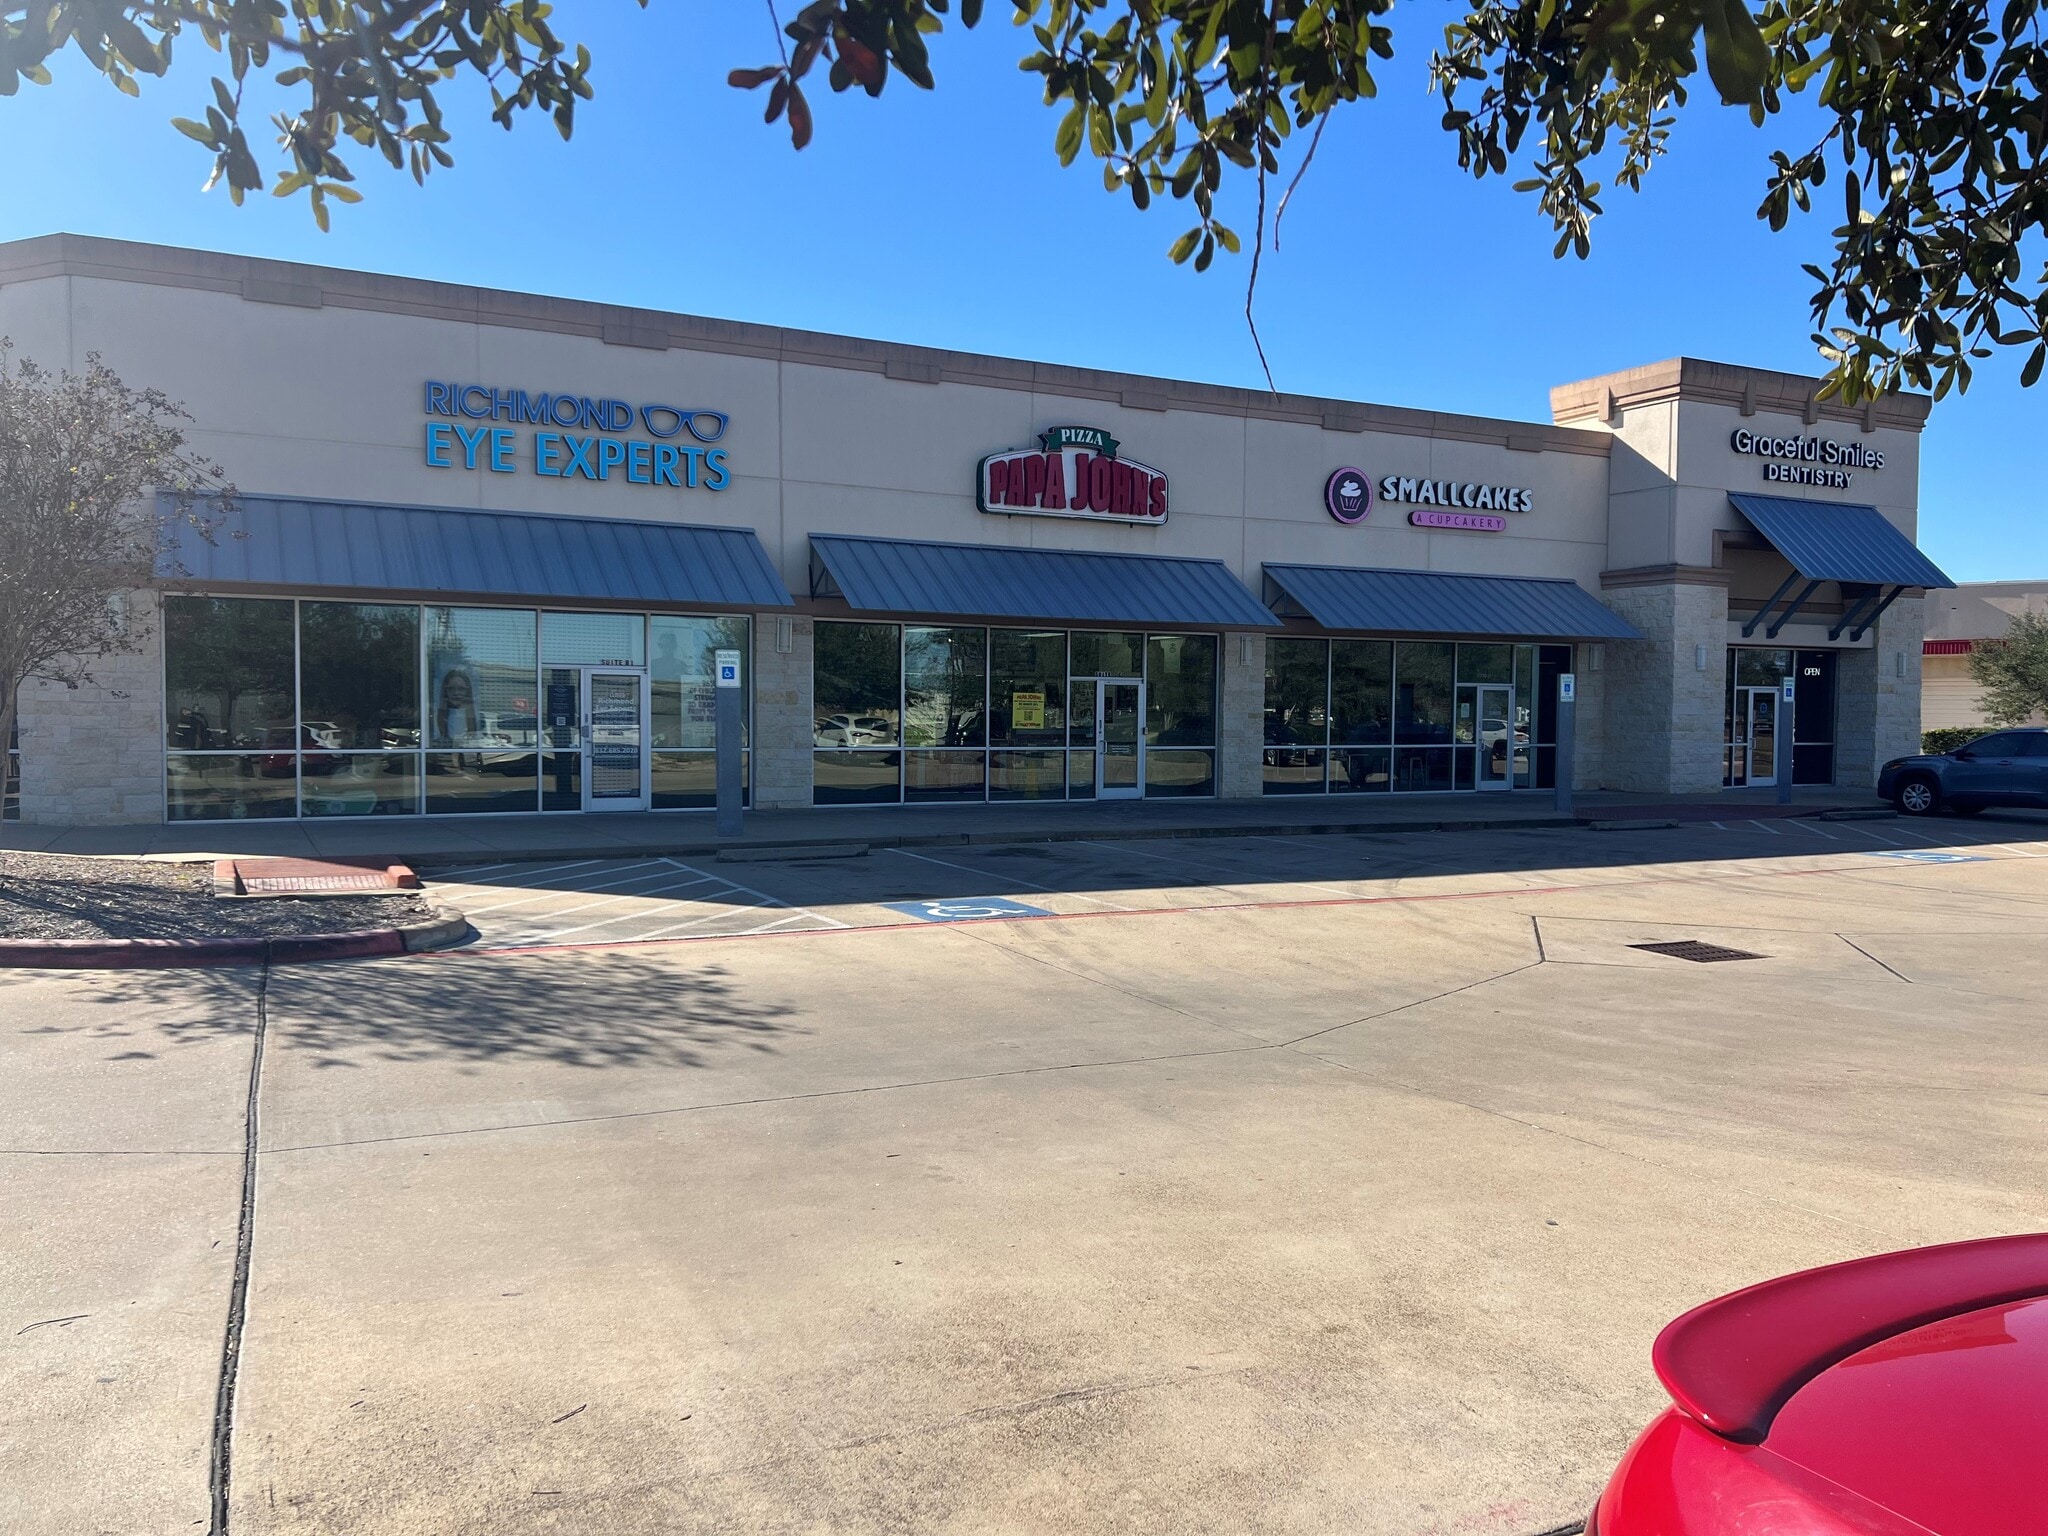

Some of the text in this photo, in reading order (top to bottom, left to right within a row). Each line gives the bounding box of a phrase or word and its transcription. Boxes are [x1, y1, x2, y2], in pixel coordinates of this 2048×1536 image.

[425, 381, 635, 432] RICHMOND
[1061, 429, 1103, 446] PIZZA
[1734, 428, 1885, 469] Graceful Smiles
[426, 422, 731, 491] EYE EXPERTS
[989, 453, 1166, 517] PAPA JOHN'S
[1767, 464, 1853, 488] DENTISTRY
[1381, 476, 1533, 512] SMALLCAKES
[1416, 514, 1502, 529] A CUPCAKERY
[1804, 667, 1820, 676] OPEN
[598, 697, 634, 705] Richmond
